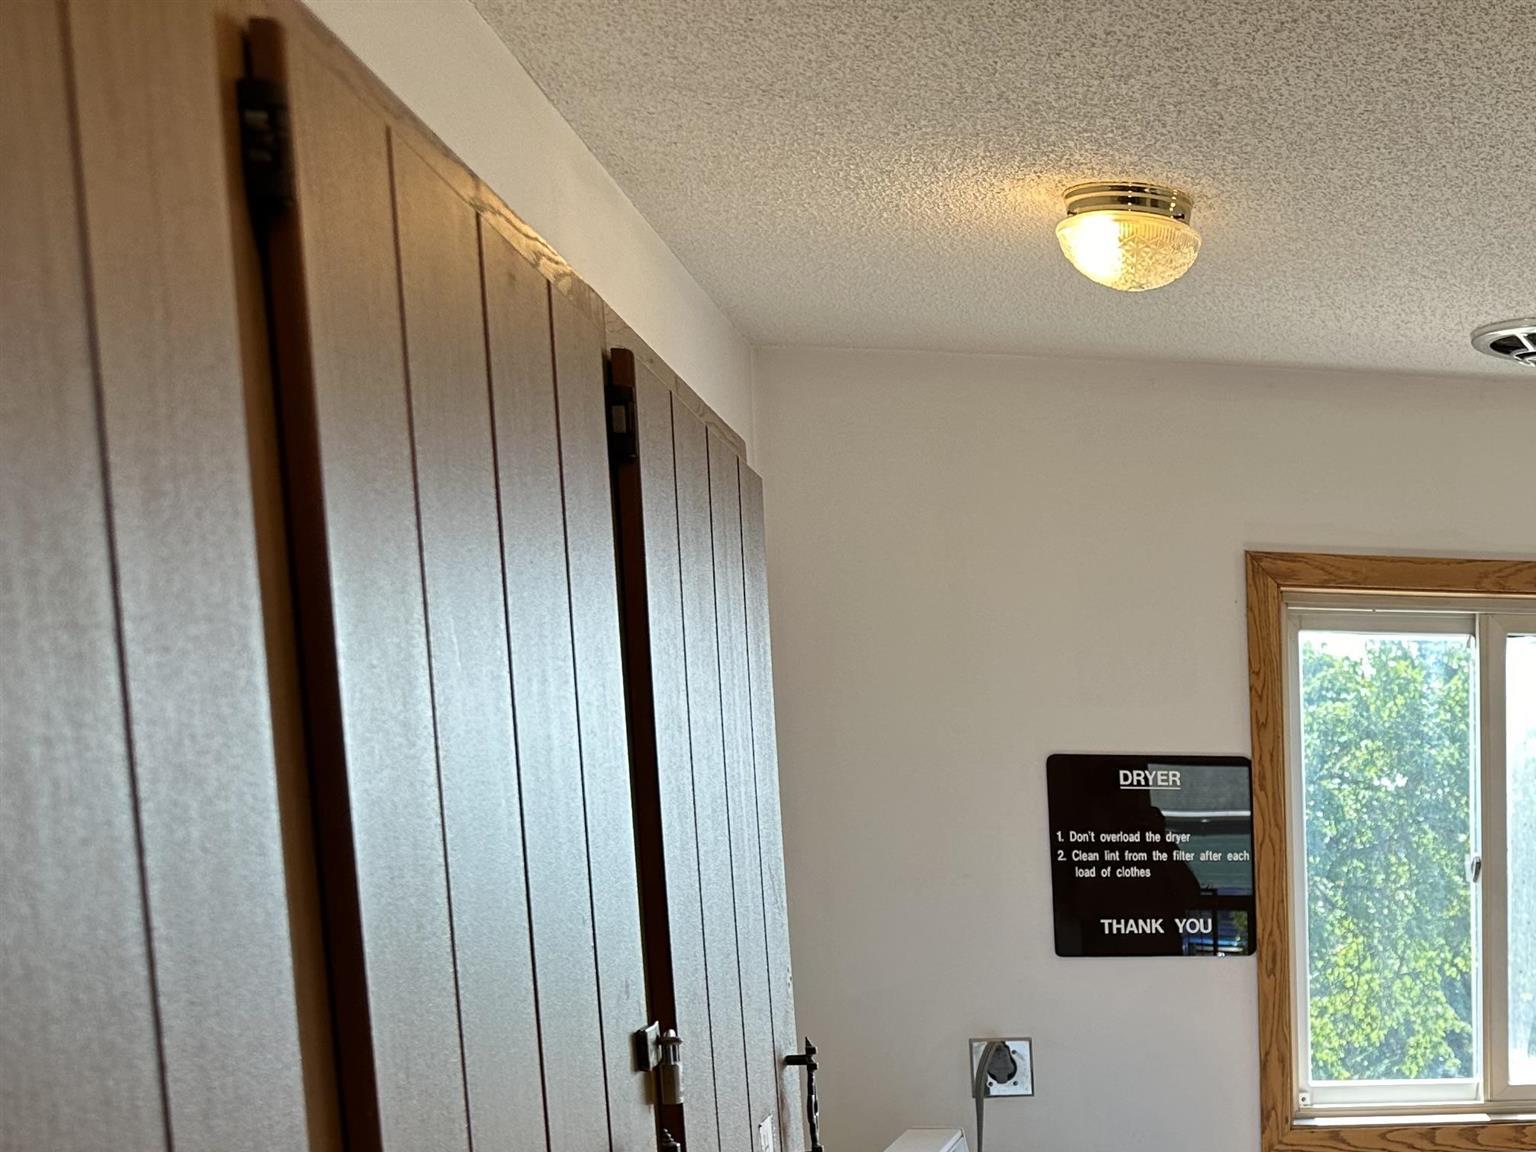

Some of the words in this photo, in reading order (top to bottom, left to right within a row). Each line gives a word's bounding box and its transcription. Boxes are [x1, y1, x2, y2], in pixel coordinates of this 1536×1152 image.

[1119, 770, 1181, 786] DRYER
[1057, 831, 1064, 842] 1.
[1070, 831, 1095, 842] Don't
[1100, 831, 1140, 842] overload
[1146, 832, 1160, 842] the
[1166, 832, 1190, 844] dryer
[1057, 850, 1067, 860] 2.
[1072, 850, 1099, 861] Clean
[1104, 851, 1119, 861] lint
[1125, 851, 1147, 861] from
[1153, 851, 1168, 861] the
[1173, 851, 1194, 861] filter
[1200, 851, 1221, 861] after
[1227, 851, 1249, 861] each
[1075, 867, 1095, 877] load
[1101, 867, 1111, 877] of
[1116, 867, 1151, 877] clothes
[1101, 919, 1164, 934] THANK
[1175, 919, 1212, 934] YOU
